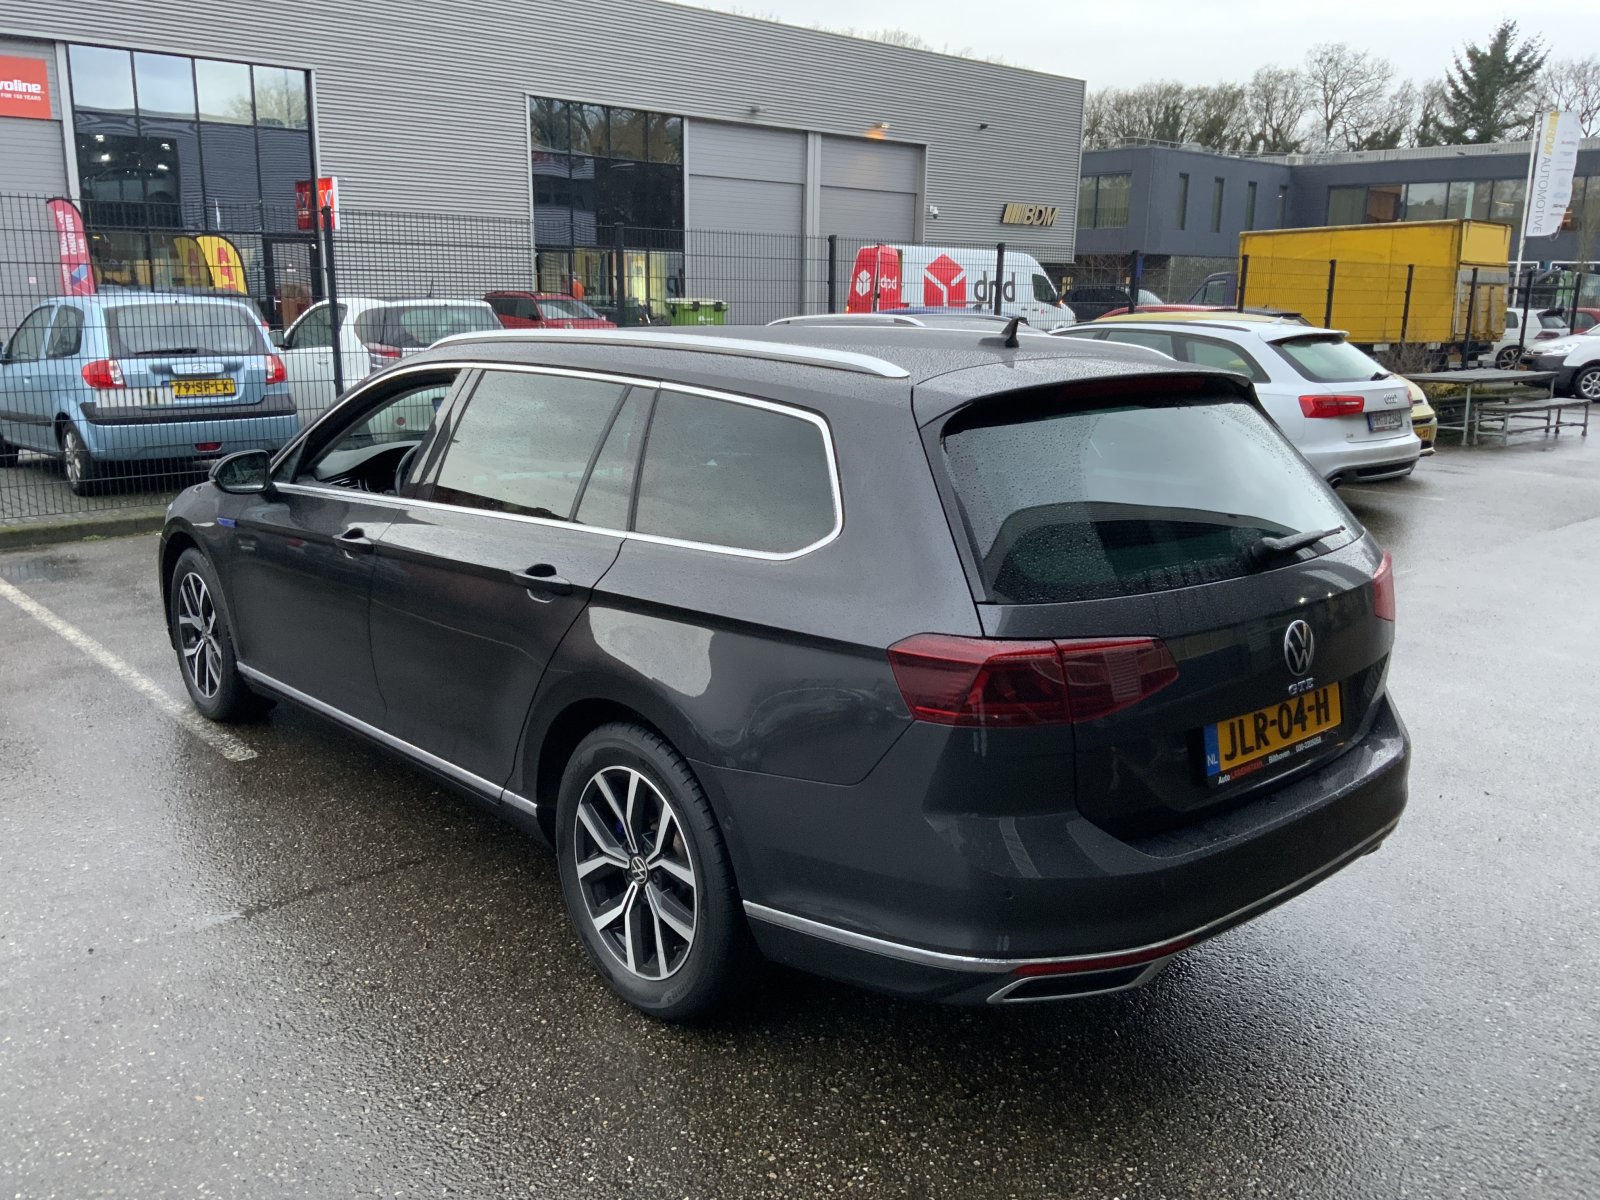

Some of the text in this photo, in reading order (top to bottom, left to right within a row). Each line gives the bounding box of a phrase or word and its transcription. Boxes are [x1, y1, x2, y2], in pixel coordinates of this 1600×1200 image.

[1532, 156, 1551, 233] AUTOMOTIVE
[880, 274, 897, 292] dpd
[1288, 677, 1314, 695] GTE
[1224, 688, 1331, 762] JLR-04-H
[1207, 753, 1218, 767] NL
[1217, 774, 1231, 784] Auto
